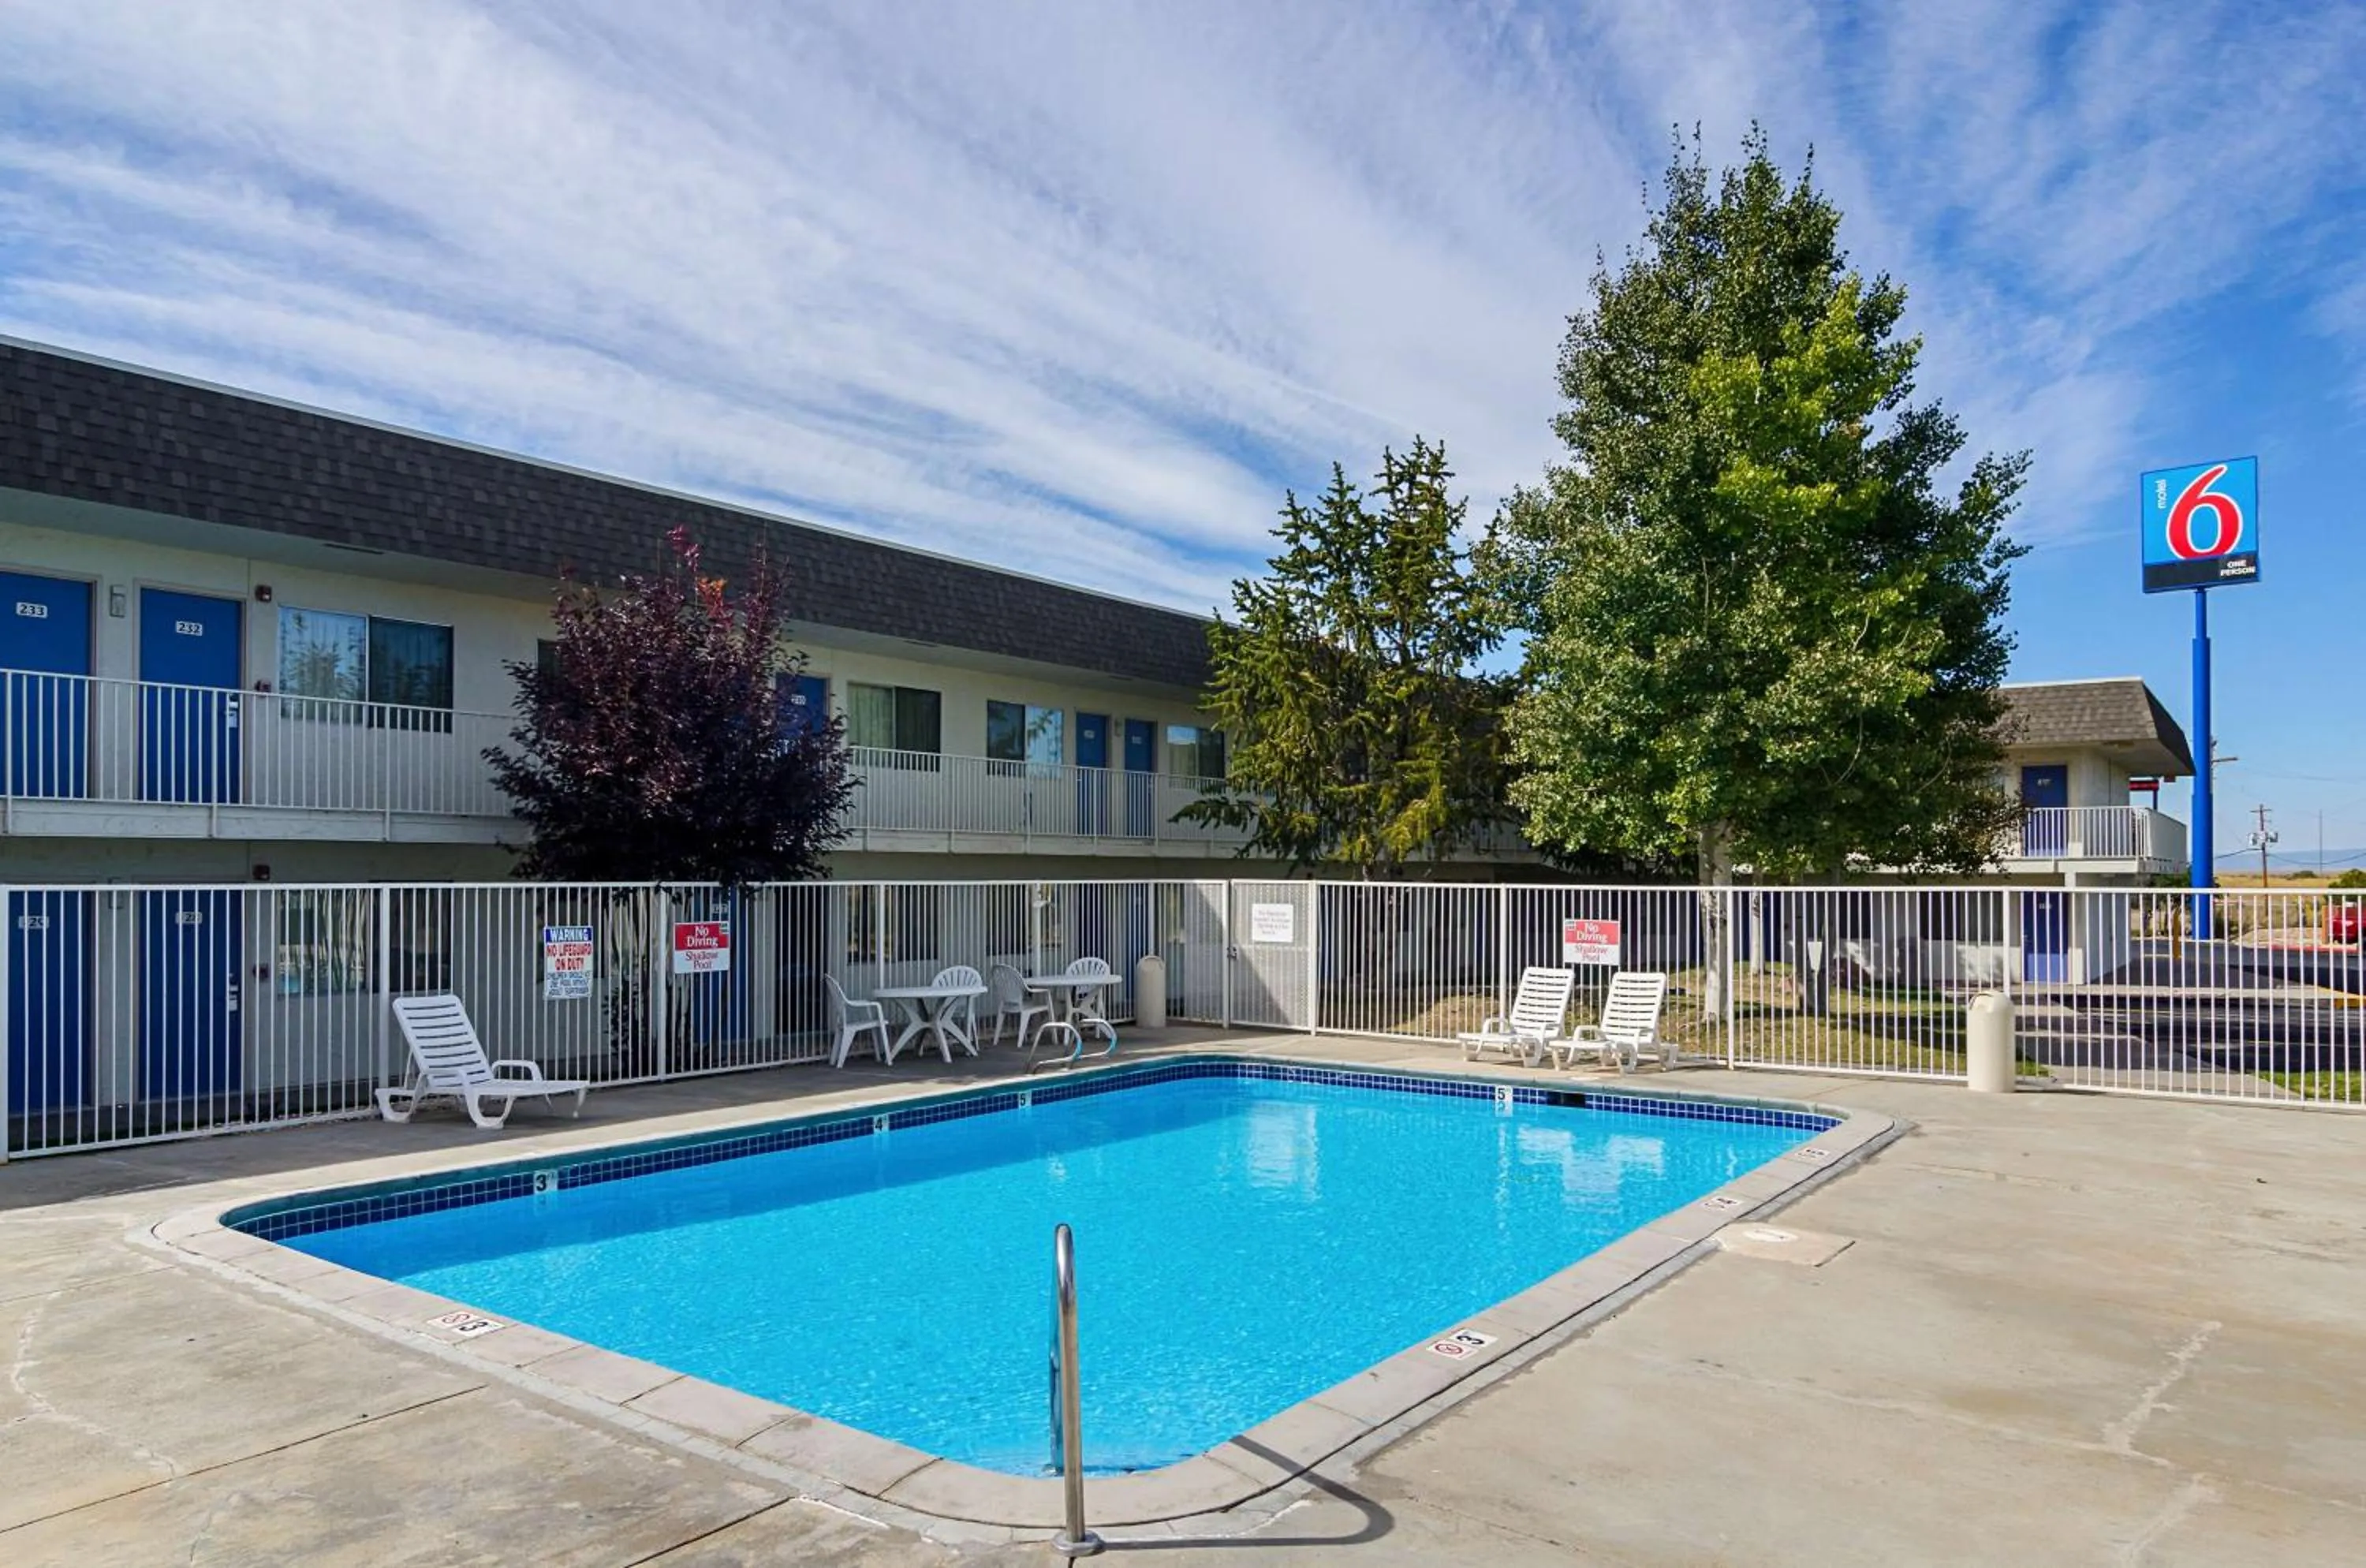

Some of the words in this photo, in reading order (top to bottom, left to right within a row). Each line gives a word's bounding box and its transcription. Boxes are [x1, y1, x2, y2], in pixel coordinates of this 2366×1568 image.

[2166, 464, 2244, 559] 6
[2227, 559, 2247, 568] ONE
[20, 603, 45, 616] 233
[695, 925, 709, 936] No
[1584, 922, 1599, 932] No
[550, 928, 589, 941] WARNING
[686, 935, 718, 947] Diving
[1577, 931, 1608, 943] Diving
[1021, 1092, 1026, 1106] 5
[1498, 1087, 1506, 1100] 5
[875, 1117, 883, 1131] 4
[536, 1174, 547, 1192] 3
